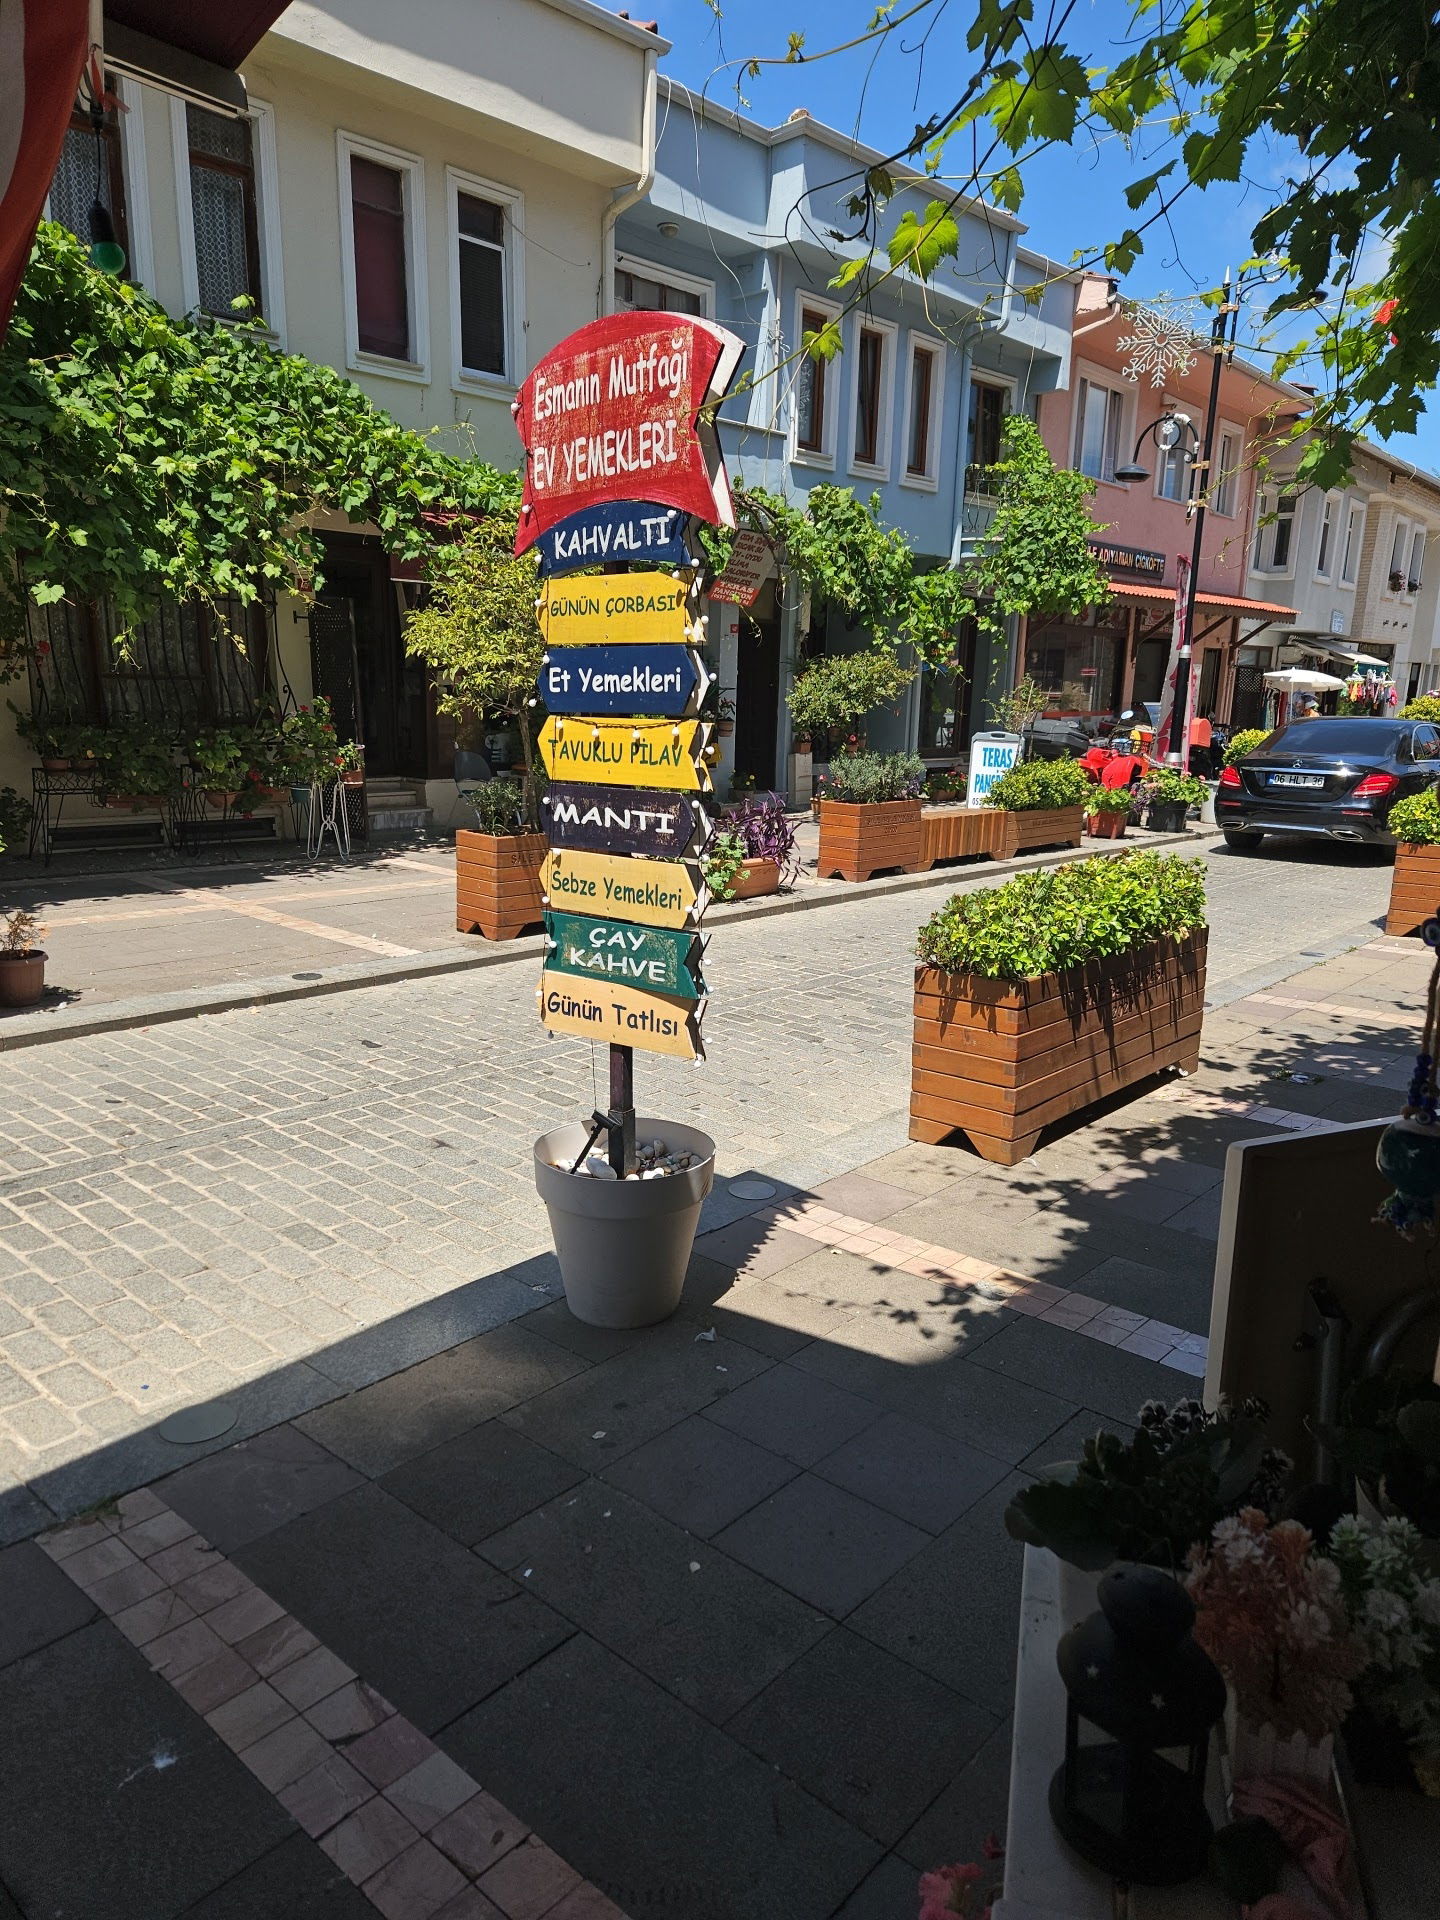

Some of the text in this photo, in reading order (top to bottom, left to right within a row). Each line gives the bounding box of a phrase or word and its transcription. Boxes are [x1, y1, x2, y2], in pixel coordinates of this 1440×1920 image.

[534, 336, 688, 422] Esmanın Mutfağı
[533, 410, 677, 490] EV YEMEKLERİ
[554, 516, 670, 560] KAHVALTI
[550, 594, 676, 617] GÜNÜN ÇORBASI
[549, 665, 681, 694] Et Yemekleri
[548, 738, 683, 767] TAVUKLU PİLAV
[982, 747, 1013, 769] TERAS
[1274, 774, 1323, 786] 06 HLT 36
[553, 802, 675, 834] MANTI
[551, 870, 682, 911] Sebze Yemekleri
[588, 927, 647, 952] ÇAY
[569, 947, 667, 983] KAHVE
[547, 991, 678, 1036] Günün Tatlısı
